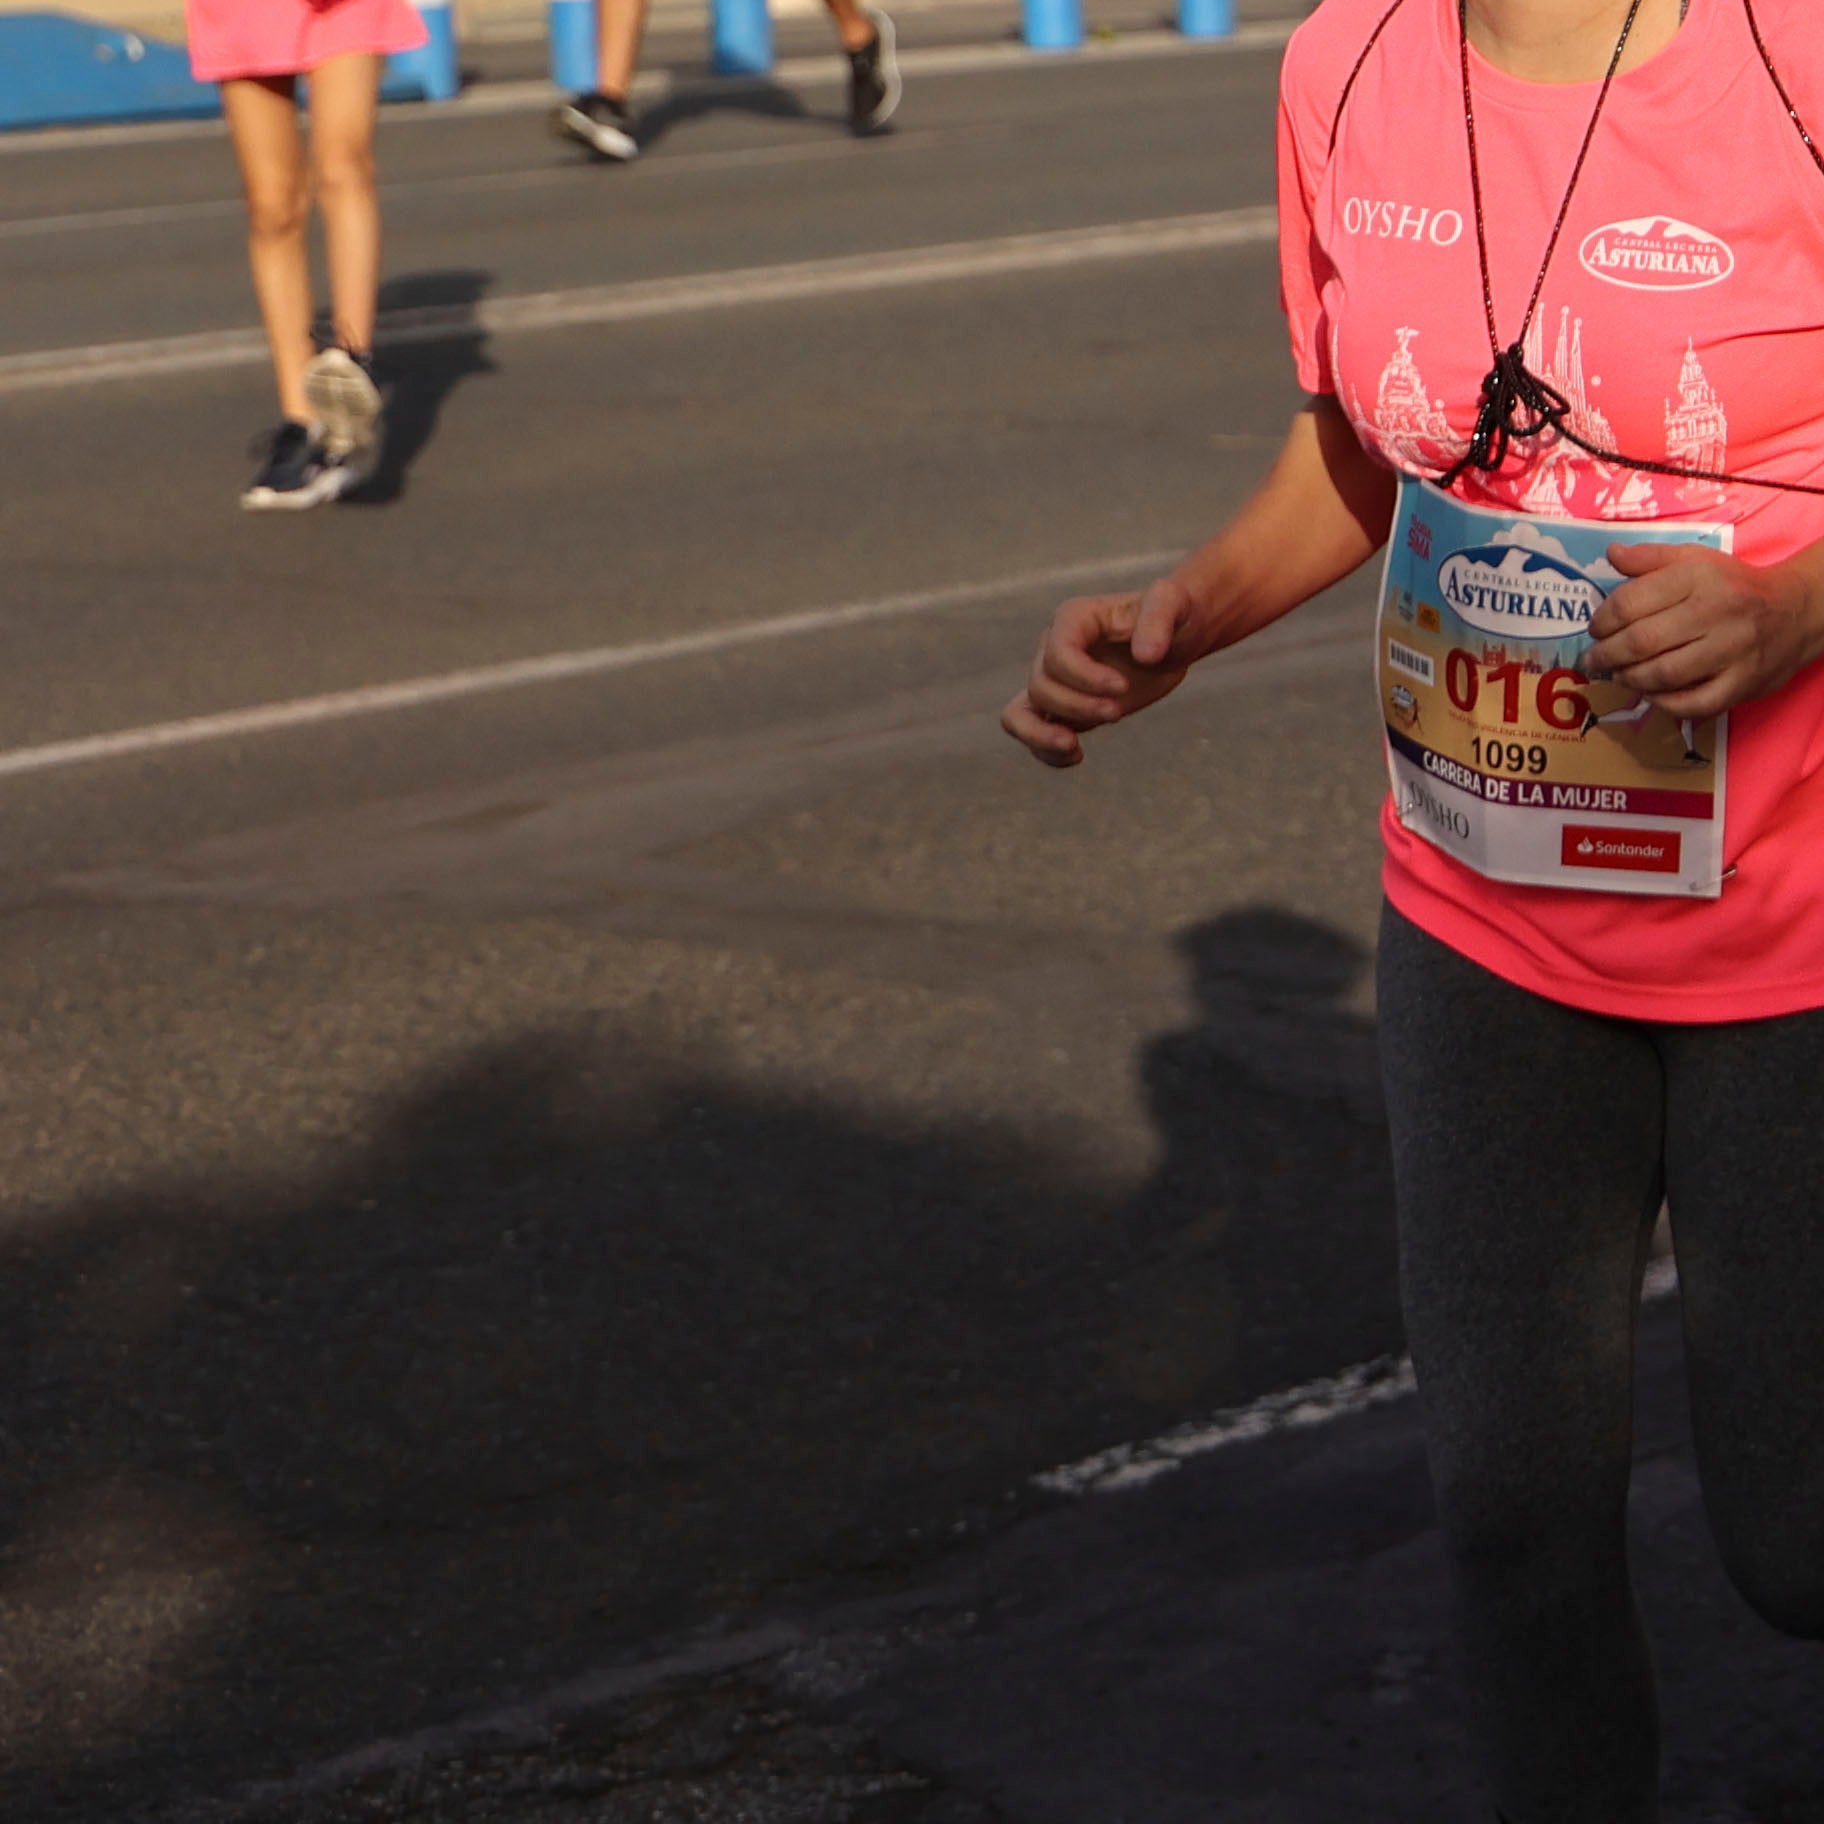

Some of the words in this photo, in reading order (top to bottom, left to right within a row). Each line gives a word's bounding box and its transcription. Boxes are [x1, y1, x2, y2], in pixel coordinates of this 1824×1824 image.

[1343, 197, 1463, 246] OYSHO
[1587, 237, 1721, 275] ASTURIANA
[1613, 237, 1660, 249] CENTRAL
[1664, 241, 1719, 254] LECHERA
[1446, 567, 1592, 622] ASTURIANA
[1464, 569, 1520, 587] CENTRAL
[1525, 578, 1589, 595] LECHERA
[1445, 648, 1590, 730] 016
[1472, 735, 1548, 775] 1099
[1423, 751, 1482, 798] CARRERA
[1485, 779, 1510, 801] DE
[1517, 781, 1545, 804] LA
[1552, 786, 1627, 811] MUJER
[1410, 781, 1470, 841] OYSHO
[1596, 840, 1665, 858] Santander
